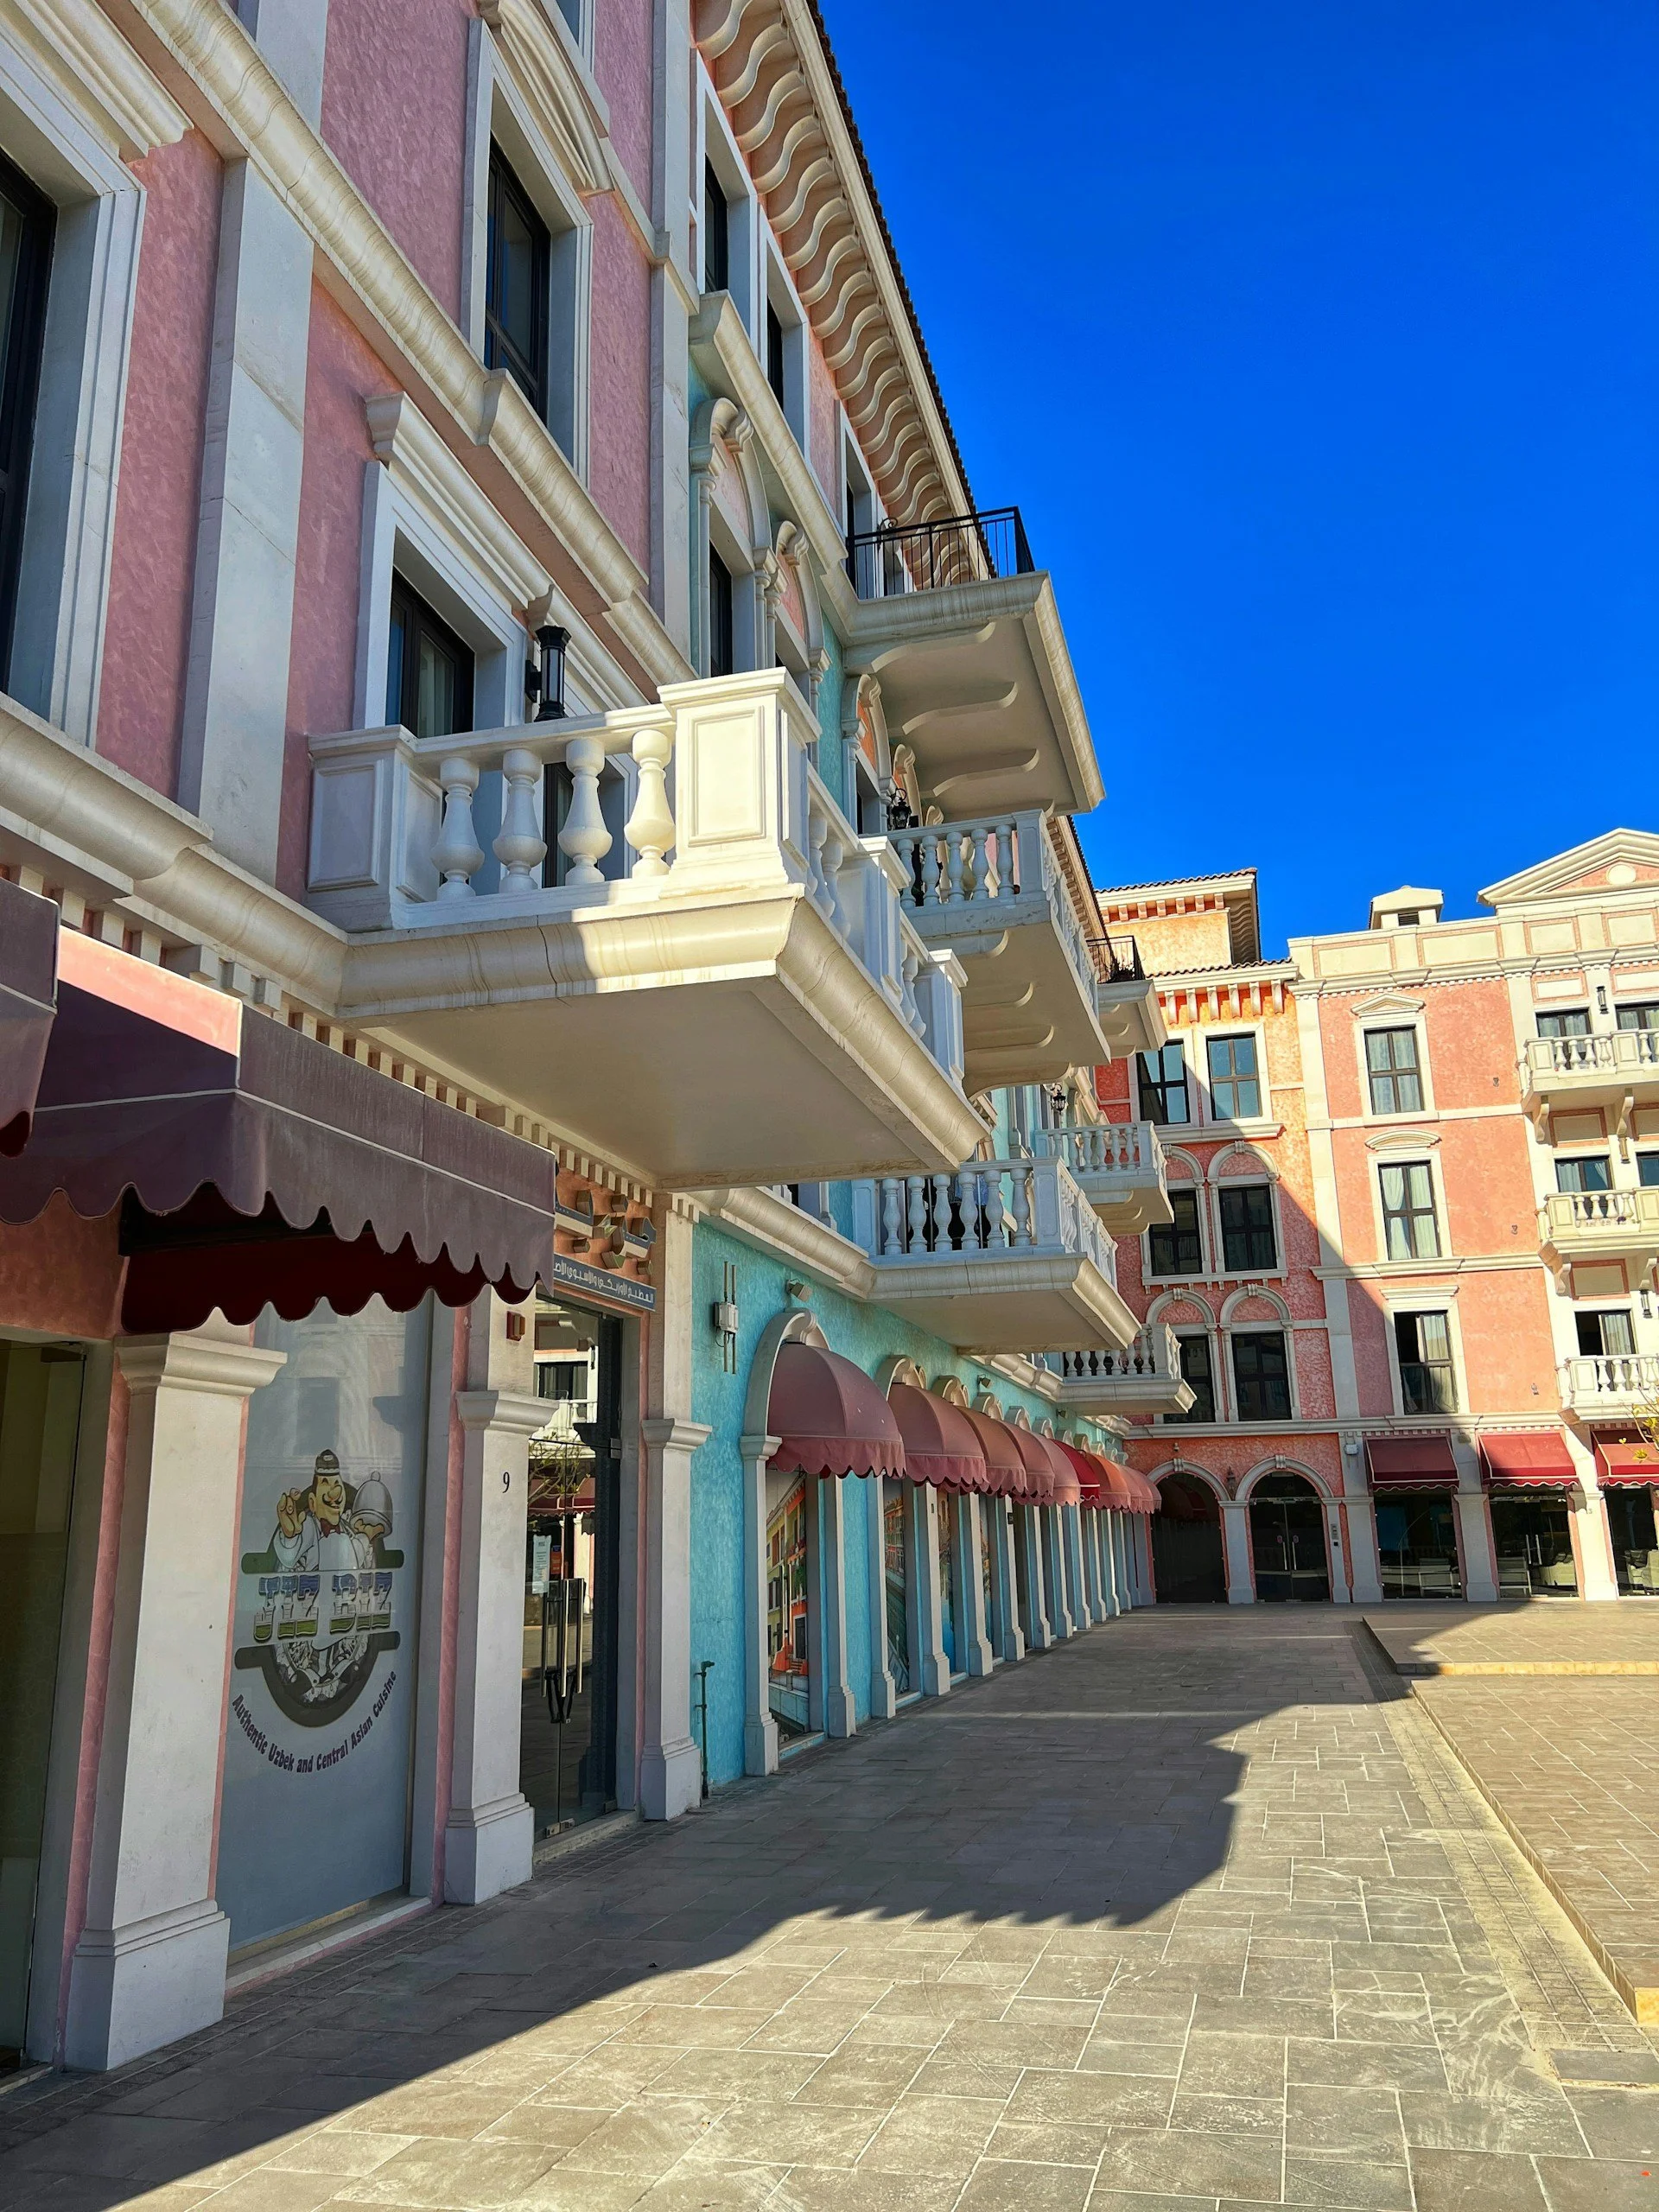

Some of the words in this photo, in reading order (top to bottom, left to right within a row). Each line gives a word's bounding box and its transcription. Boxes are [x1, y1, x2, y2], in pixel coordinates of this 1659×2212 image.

[553, 1259, 567, 1276] الأص
[502, 1471, 510, 1494] 9
[253, 1573, 321, 1643] JIZ
[329, 1571, 393, 1635] BIZ
[232, 1694, 269, 1755] Authentic
[268, 1743, 295, 1771] Uzbek
[296, 1755, 314, 1773] and
[316, 1739, 348, 1771] Central
[350, 1716, 373, 1750] Asian
[372, 1670, 397, 1718] Cuisine
